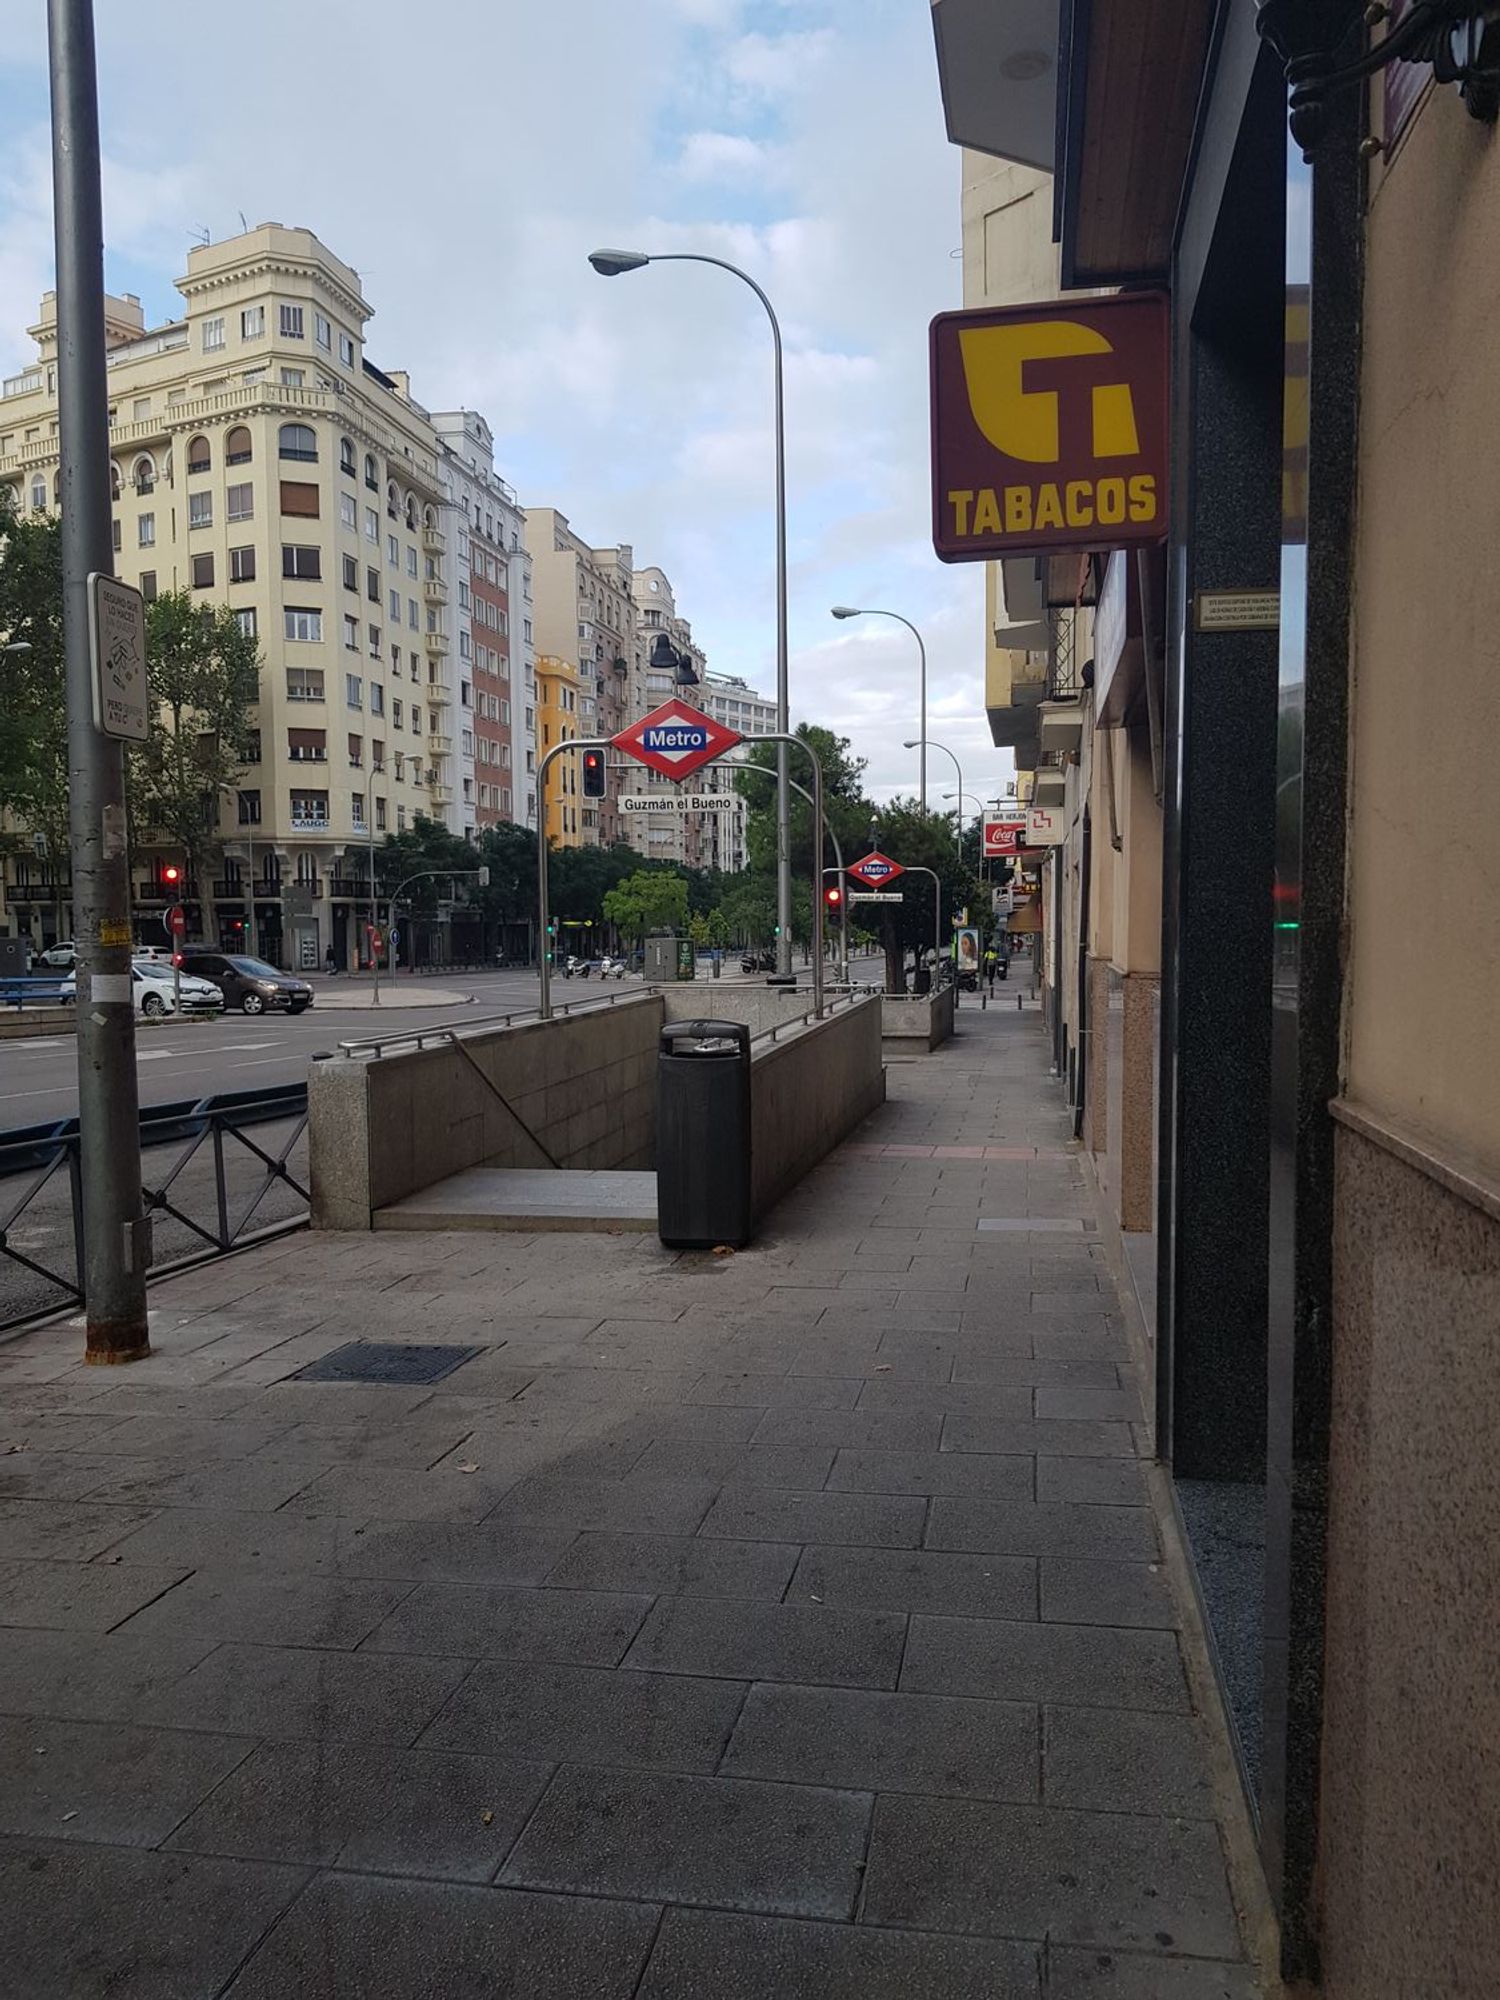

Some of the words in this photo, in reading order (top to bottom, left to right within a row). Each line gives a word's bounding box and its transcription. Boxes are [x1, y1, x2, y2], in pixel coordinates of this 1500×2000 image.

[948, 474, 1157, 536] TABACOS
[649, 730, 702, 747] Metro
[624, 798, 674, 811] Guzmán
[677, 798, 688, 809] el
[691, 798, 731, 810] Bueno
[864, 865, 888, 873] Metro
